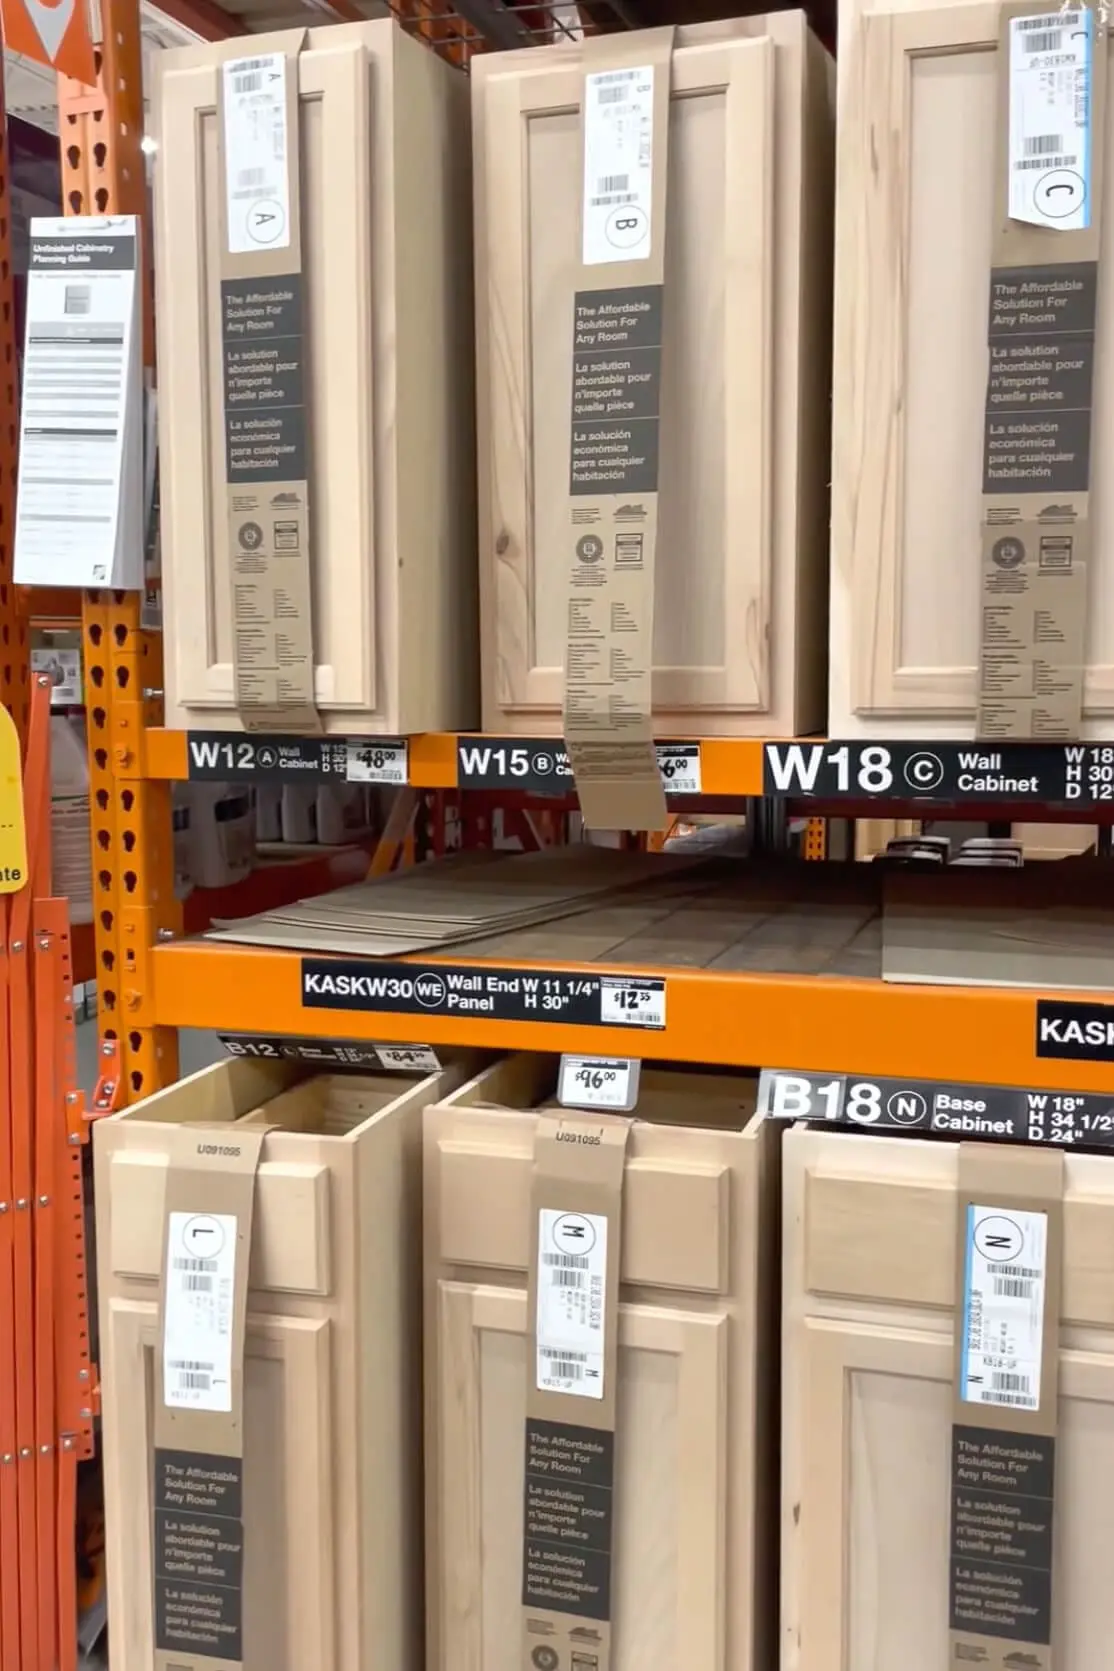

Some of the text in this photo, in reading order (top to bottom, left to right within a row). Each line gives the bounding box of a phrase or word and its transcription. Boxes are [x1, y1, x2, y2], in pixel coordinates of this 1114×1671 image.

[1046, 184, 1074, 197] C
[256, 213, 275, 225] A
[616, 218, 638, 230] B
[33, 254, 67, 264] Planning
[993, 281, 1084, 295] The Affordable
[226, 290, 294, 305] The Affordable
[994, 296, 1068, 310] Solution For
[227, 306, 282, 318] Solution For
[578, 302, 651, 317] The Affordable
[227, 320, 274, 333] Any Room
[576, 317, 638, 330] Solution For
[993, 313, 1056, 327] Any Room
[576, 332, 628, 344] Any Room
[992, 346, 1059, 358] La solution
[576, 361, 630, 373] La solution
[992, 360, 1084, 372] abordable pour
[576, 373, 651, 386] abordable pour
[991, 376, 1049, 387] n'importe
[575, 388, 623, 399] n'importe
[990, 391, 1027, 403] quelle
[574, 402, 605, 414] quelle
[574, 429, 631, 441] La solución
[990, 422, 1059, 434] La solución
[574, 442, 628, 455] económica
[989, 437, 1056, 449] económica
[573, 456, 645, 470] para cualquier
[988, 452, 1075, 465] para cualquier
[572, 470, 625, 481] habitación
[988, 466, 1051, 478] habitación
[190, 742, 255, 769] W12
[262, 750, 273, 763] A
[278, 747, 300, 757] Wall
[460, 748, 529, 775] W15
[537, 757, 547, 770] B
[279, 758, 319, 769] Cabinet
[322, 763, 330, 772] D
[766, 746, 893, 792] W18
[914, 760, 934, 782] C
[958, 753, 1001, 770] Wall
[1064, 746, 1086, 764] W
[1066, 765, 1082, 781] H
[958, 774, 1039, 793] Cabinet
[1065, 782, 1081, 799] D
[304, 974, 414, 998] KASKW30
[416, 983, 442, 997] WE
[447, 974, 482, 991] Wall
[487, 977, 519, 992] End
[522, 978, 539, 993] W
[544, 980, 561, 994] 11
[567, 981, 600, 996] 1/4"
[448, 994, 569, 1011] Panel H 30"
[225, 1042, 279, 1057] B12
[772, 1076, 1085, 1123] B18 N Base W 18"
[934, 1115, 1014, 1134] Cabinet
[1029, 1110, 1044, 1125] H
[1051, 1112, 1074, 1128] 34
[1029, 1126, 1083, 1143] D 24"
[563, 1224, 584, 1238] M
[985, 1235, 1012, 1249] N
[530, 1433, 604, 1453] The Affordable
[530, 1446, 591, 1463] Solution For
[958, 1440, 1043, 1462] The Affordable
[529, 1458, 581, 1474] Any Room
[958, 1454, 1029, 1473] Solution For
[958, 1468, 1017, 1485] Any Room
